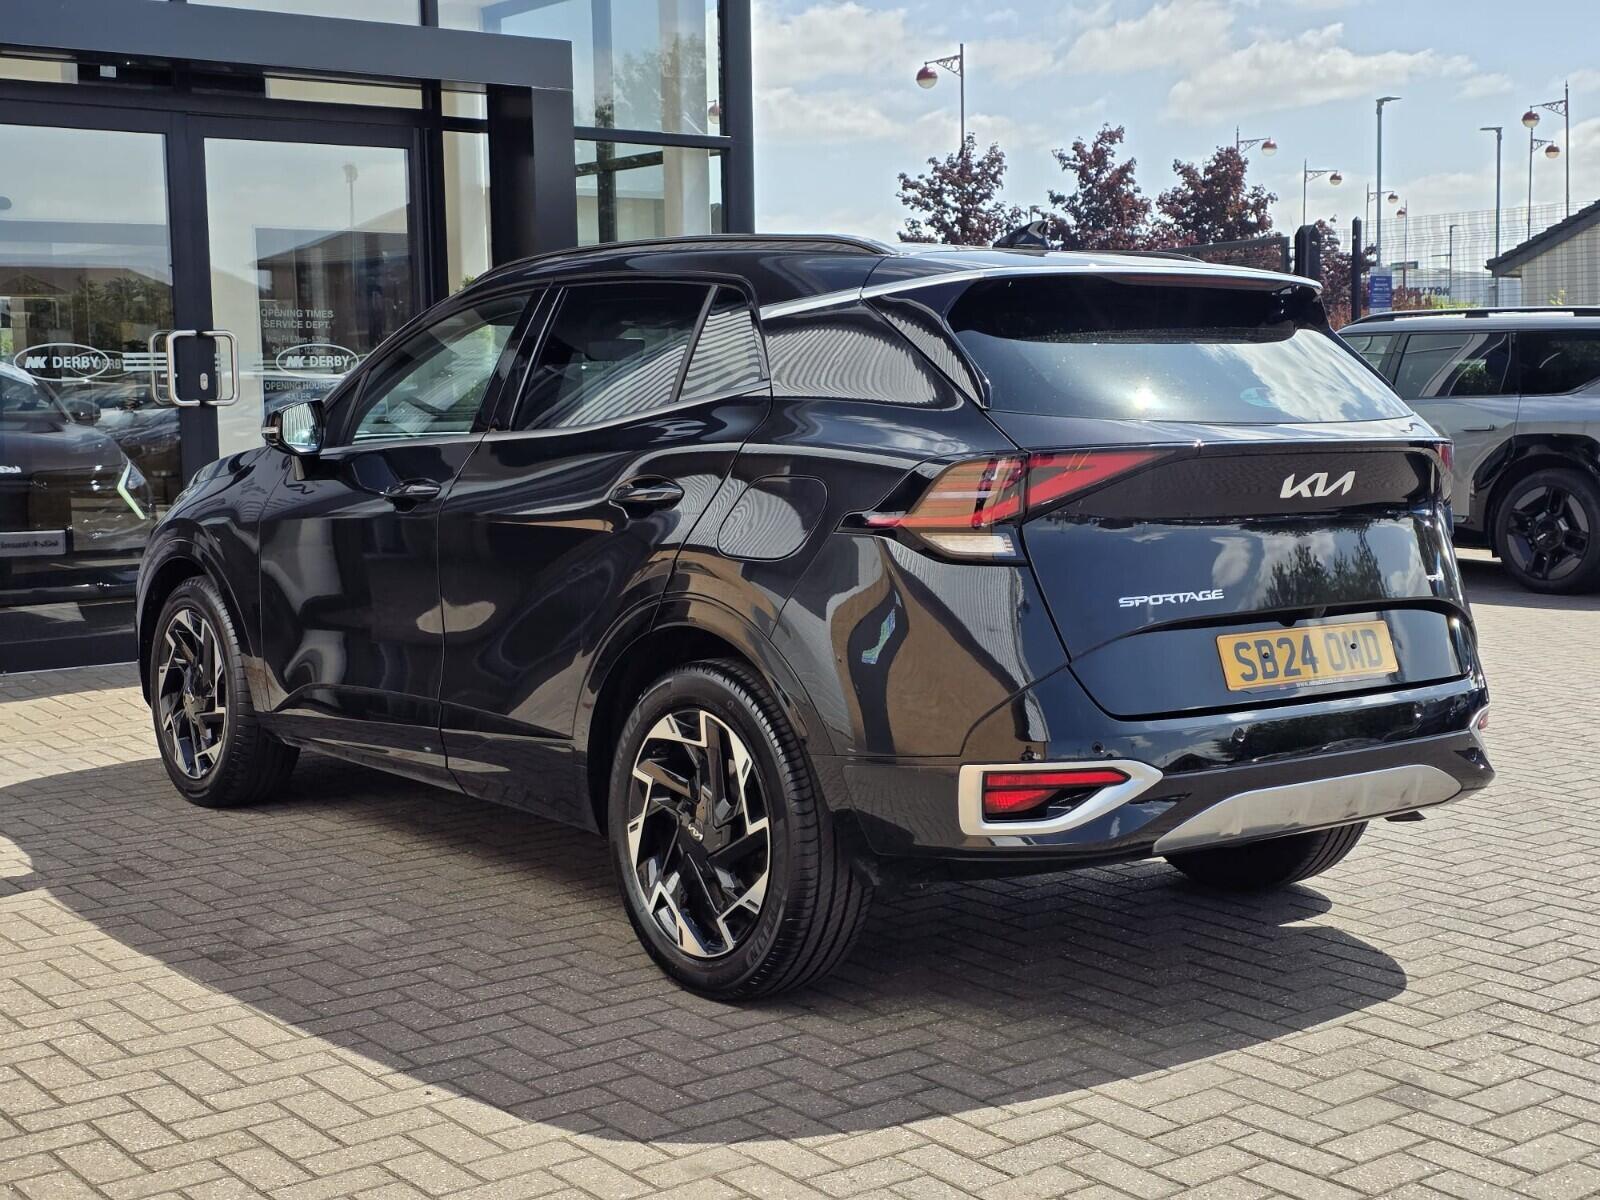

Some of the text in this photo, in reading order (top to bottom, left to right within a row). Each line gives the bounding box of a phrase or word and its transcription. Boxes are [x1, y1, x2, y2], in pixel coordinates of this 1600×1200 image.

[261, 308, 334, 318] OPENING TIMES
[263, 320, 304, 329] SERVICE
[52, 356, 99, 369] DERBY
[309, 355, 350, 368] DERBY
[265, 381, 302, 391] OPENING
[1280, 470, 1356, 499] KIA
[1118, 588, 1225, 608] SPORTAGE
[1233, 628, 1383, 683] SB24 OMD
